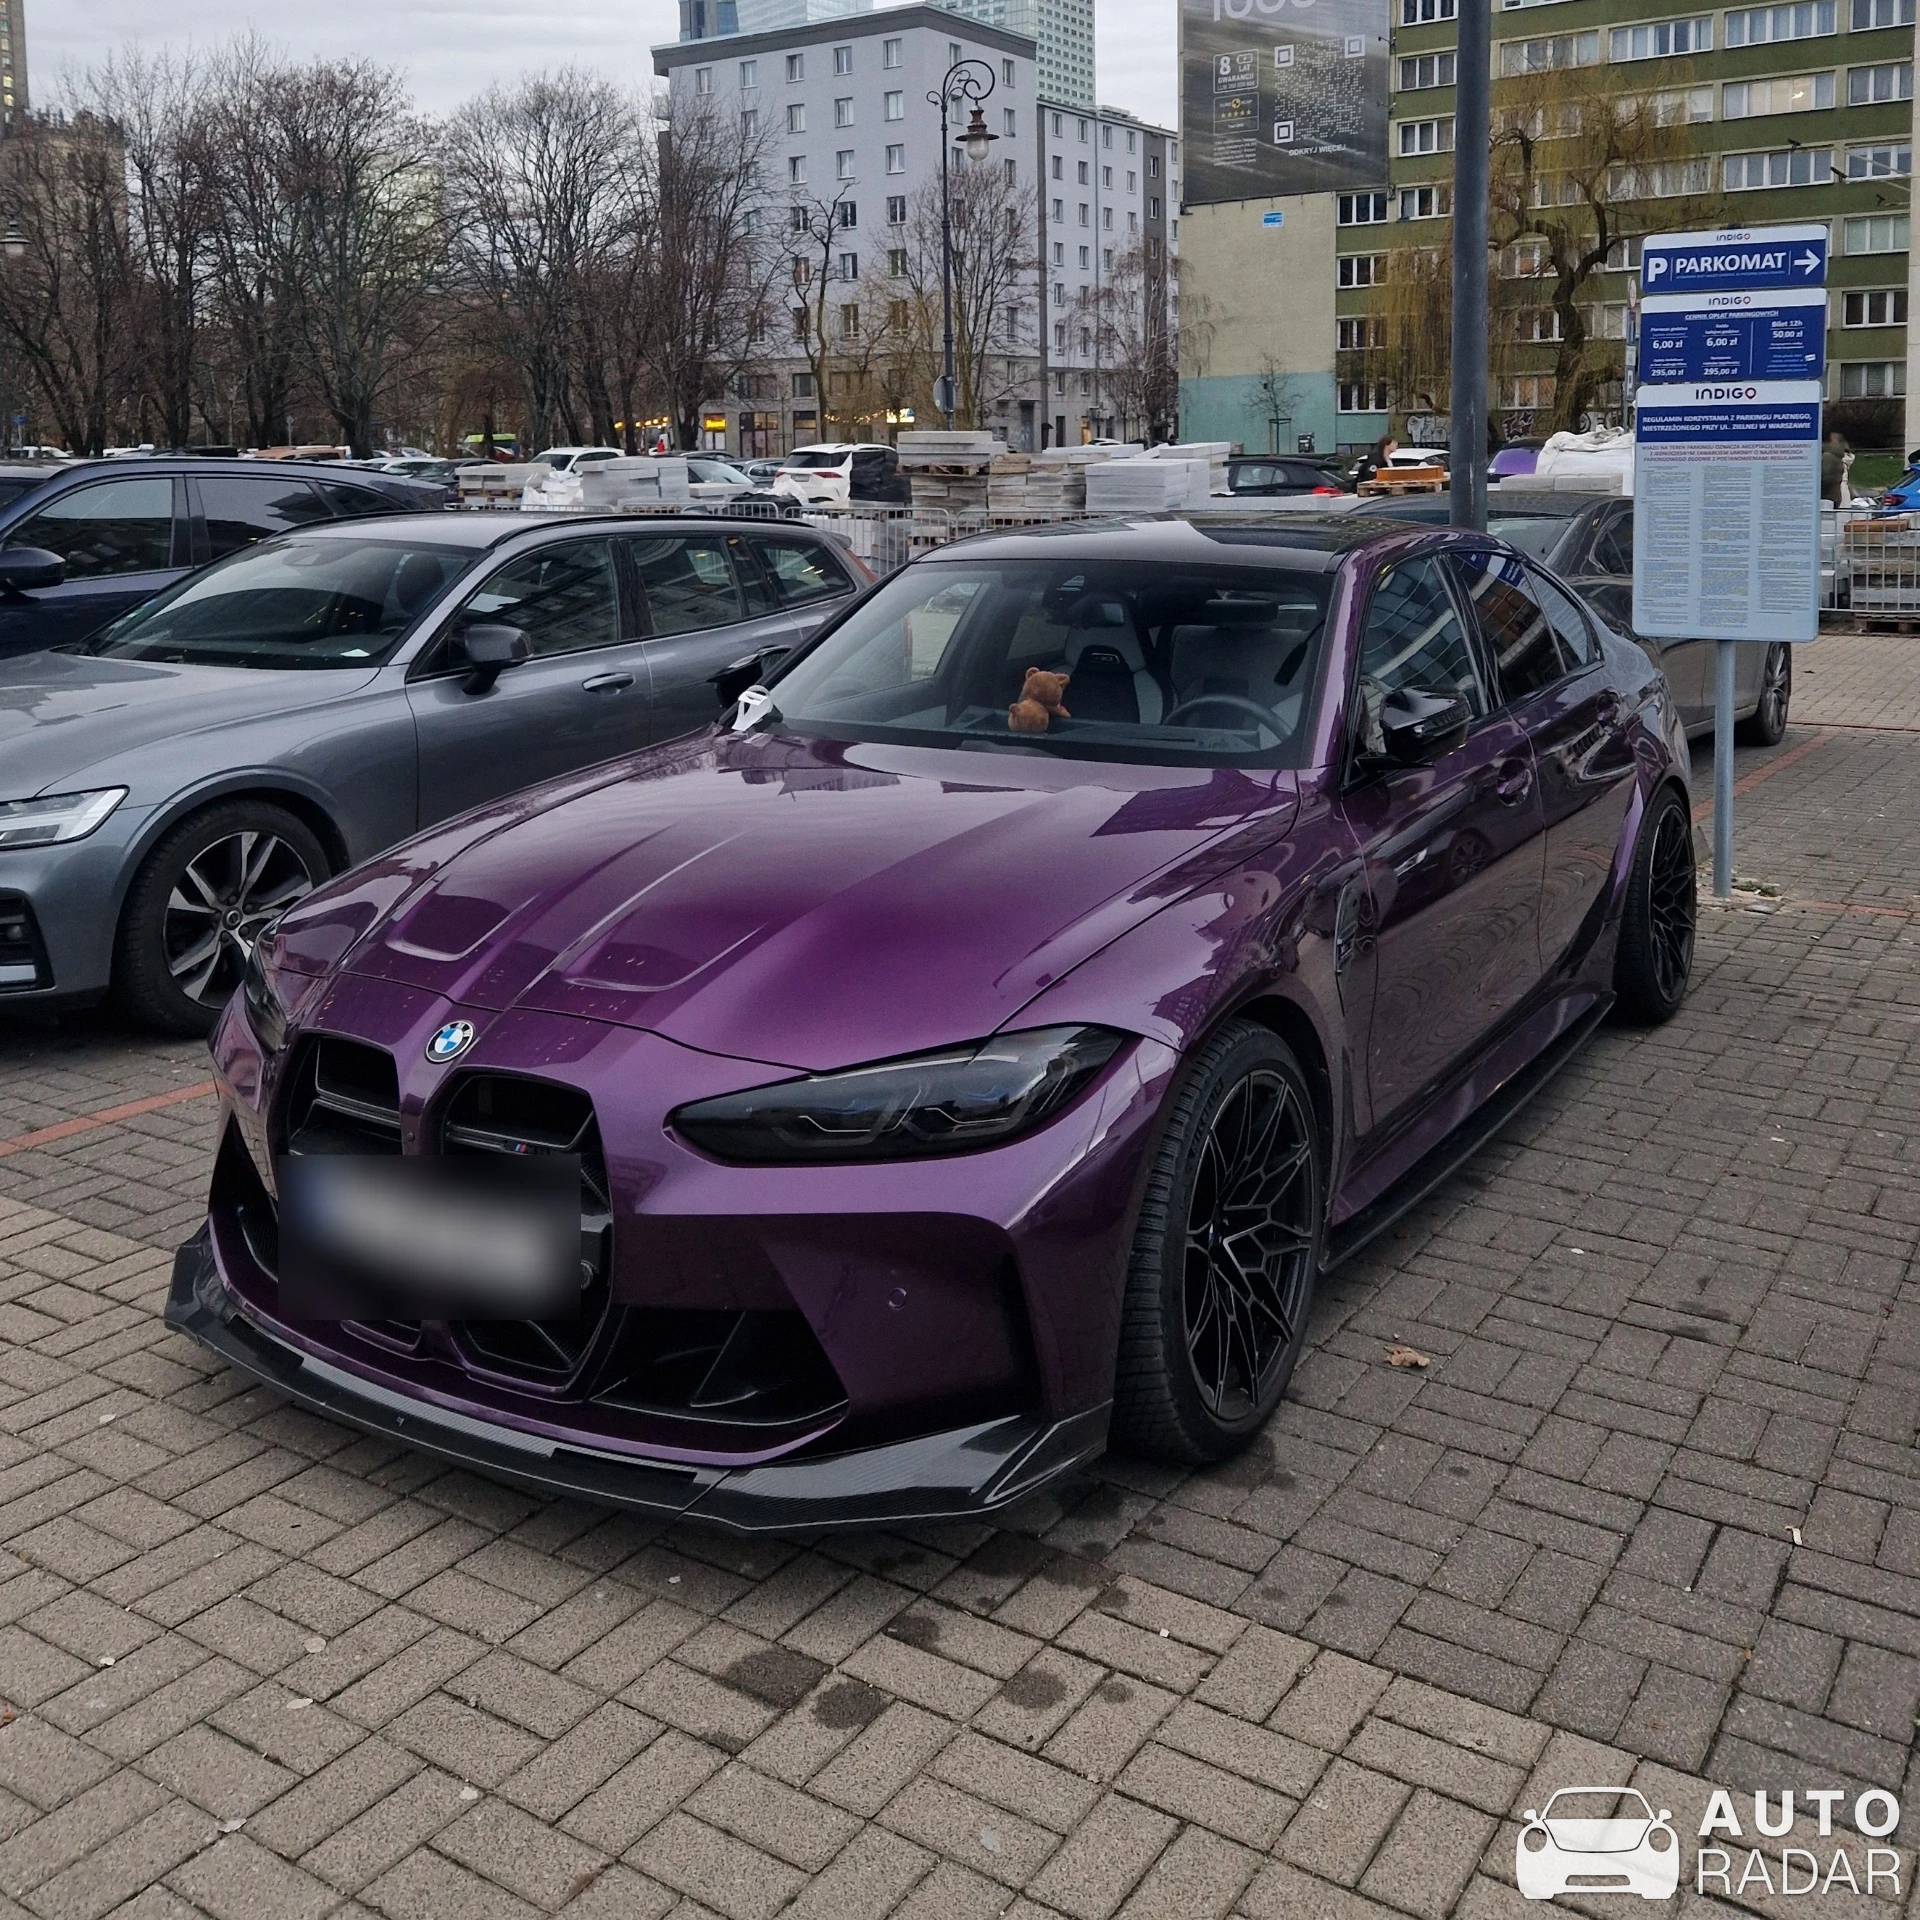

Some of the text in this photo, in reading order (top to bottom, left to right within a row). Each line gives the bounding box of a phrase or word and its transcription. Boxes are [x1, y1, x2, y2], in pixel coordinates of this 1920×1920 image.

[1220, 56, 1250, 75] 8 LAT
[1218, 73, 1254, 83] GWARANCJI
[1288, 144, 1346, 156] ODKRYJ WIĘCEJ
[1647, 252, 1787, 282] P PARKOMAT
[1709, 296, 1751, 306] INDIGO
[1772, 330, 1795, 338] 50,00
[1653, 340, 1683, 350] 6,00 zł
[1706, 337, 1738, 347] 6,00 zł
[1651, 369, 1676, 377] 295,00
[1703, 368, 1730, 376] 295,00
[1696, 387, 1756, 399] INDIGO
